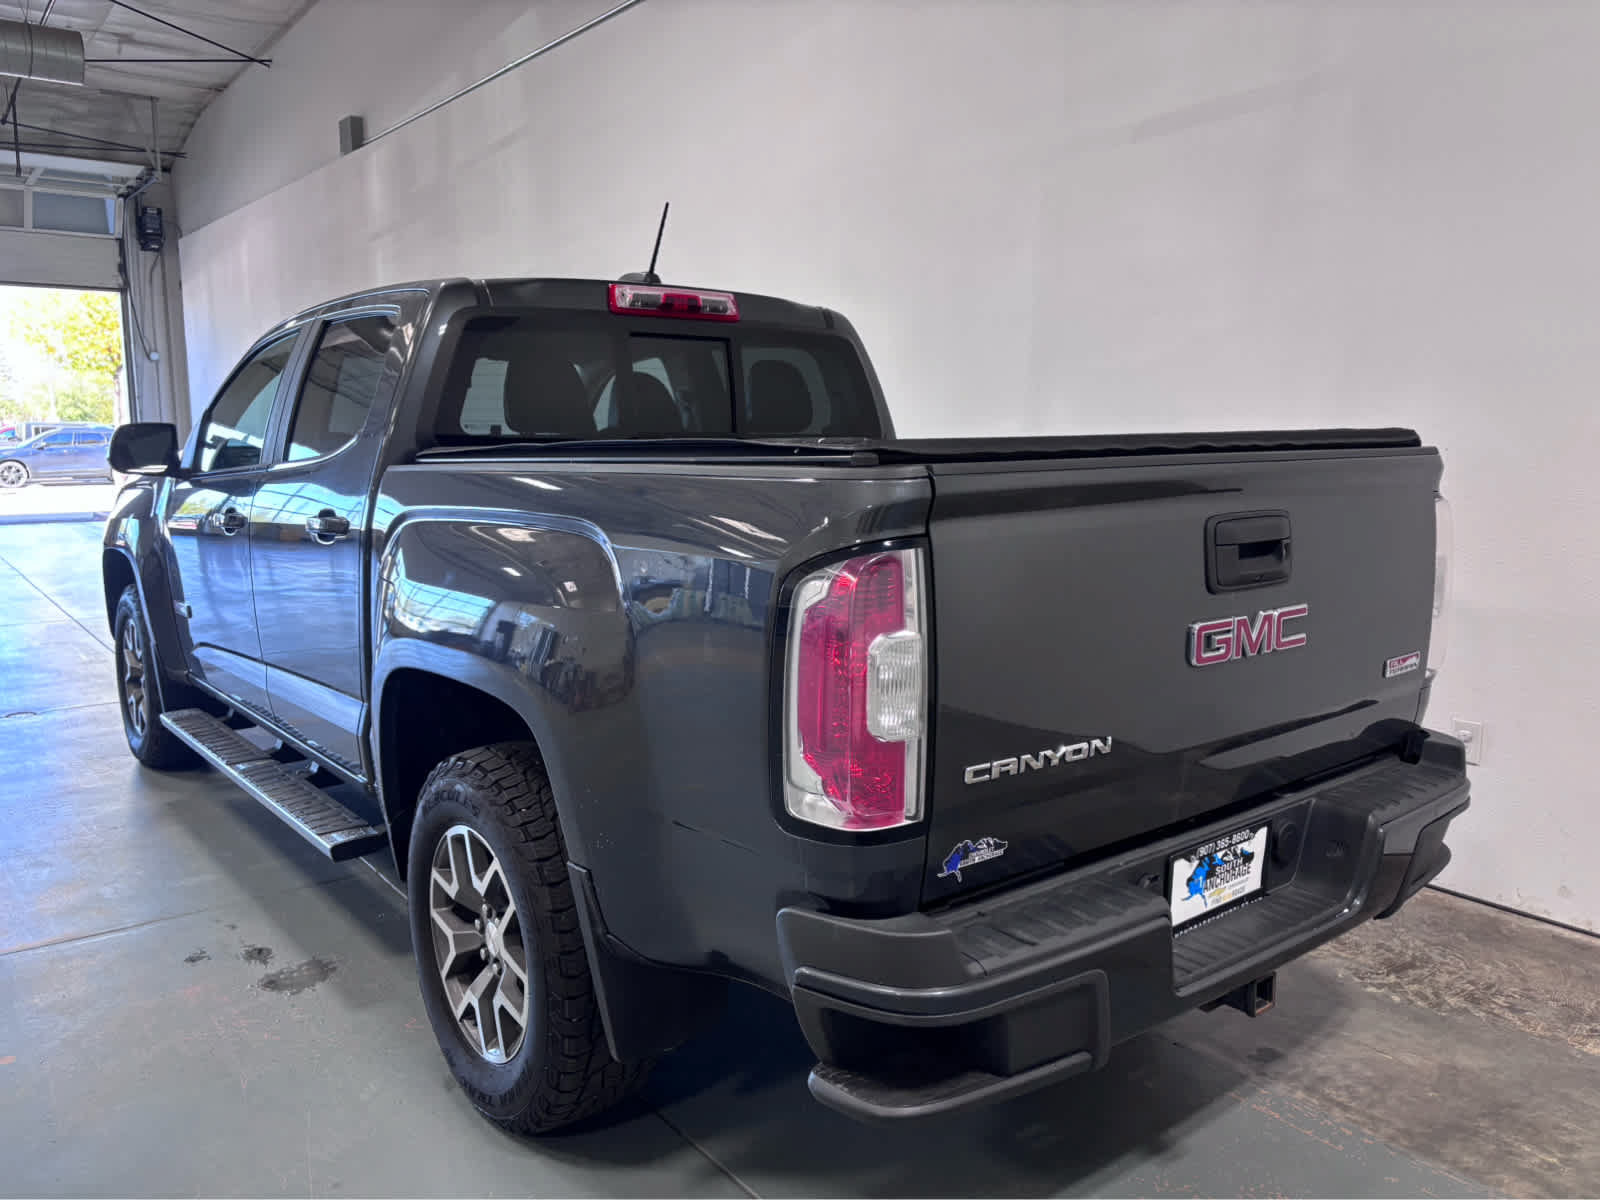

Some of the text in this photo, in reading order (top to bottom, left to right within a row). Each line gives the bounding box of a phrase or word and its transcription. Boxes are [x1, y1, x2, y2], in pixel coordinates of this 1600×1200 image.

[1189, 603, 1308, 667] GMC
[964, 736, 1112, 784] CANYON
[1205, 865, 1251, 892] ANCHORAGE
[1215, 859, 1243, 876] SOUTH
